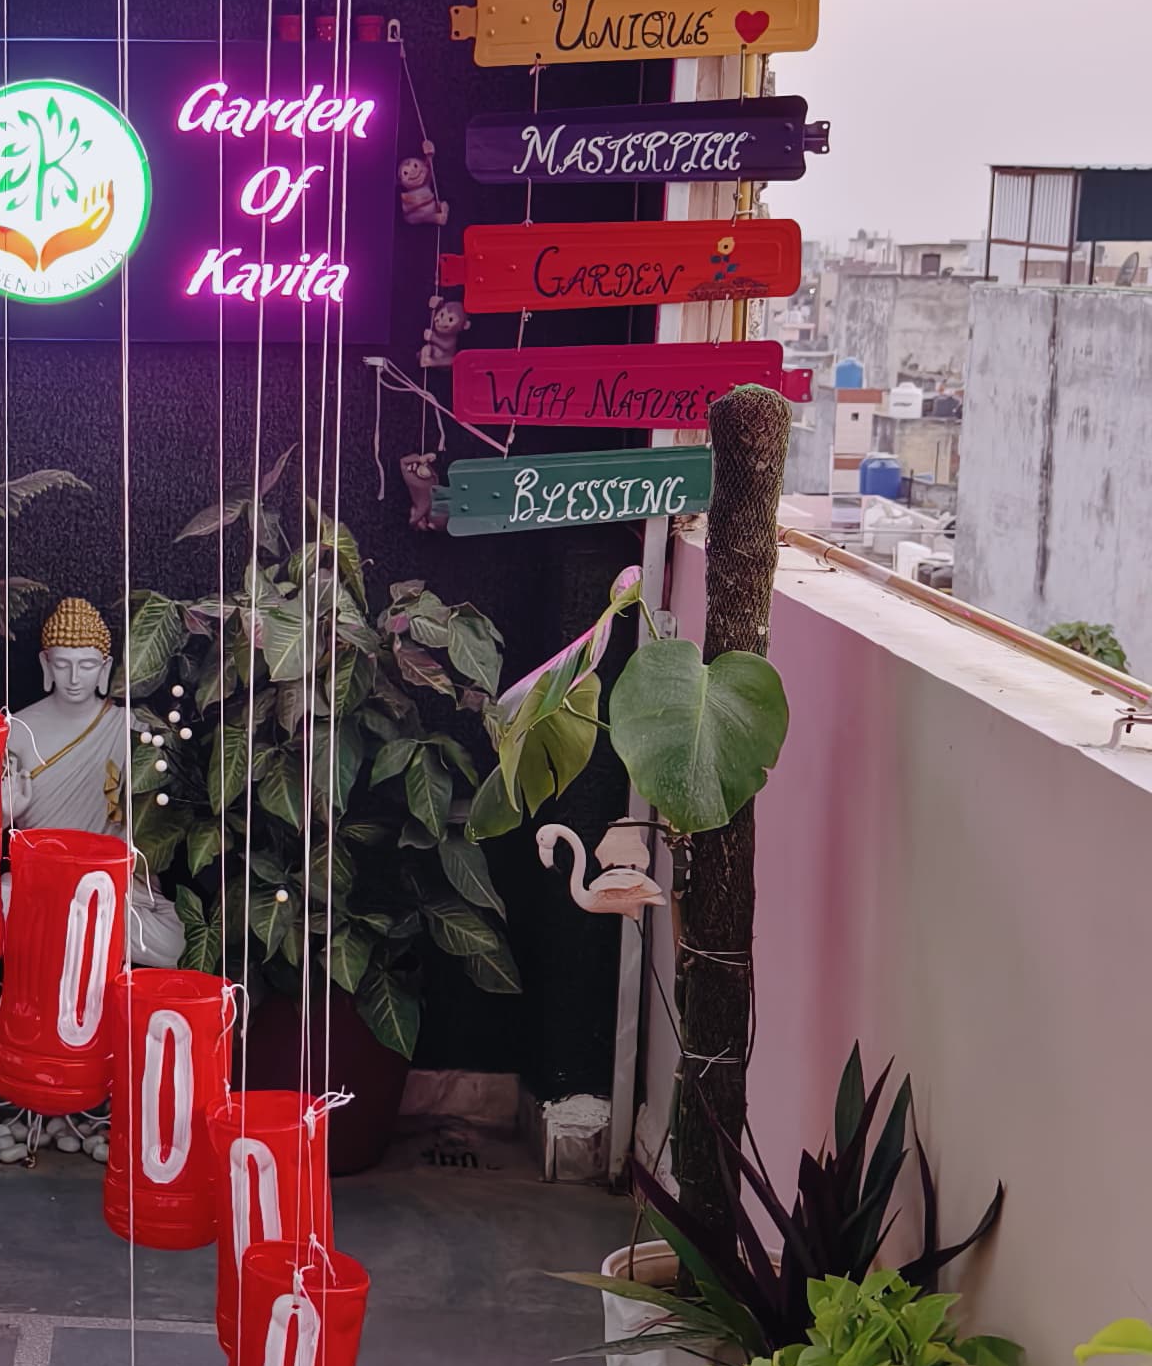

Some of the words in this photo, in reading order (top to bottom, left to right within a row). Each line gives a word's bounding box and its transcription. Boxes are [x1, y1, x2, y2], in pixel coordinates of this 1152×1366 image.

[177, 82, 375, 138] Garden
[512, 124, 752, 176] MASTERPIECE
[240, 165, 325, 223] Of
[186, 248, 350, 302] Kavita
[533, 245, 685, 299] GARDEN
[485, 366, 576, 421] WITH
[509, 467, 688, 523] BLESSING
